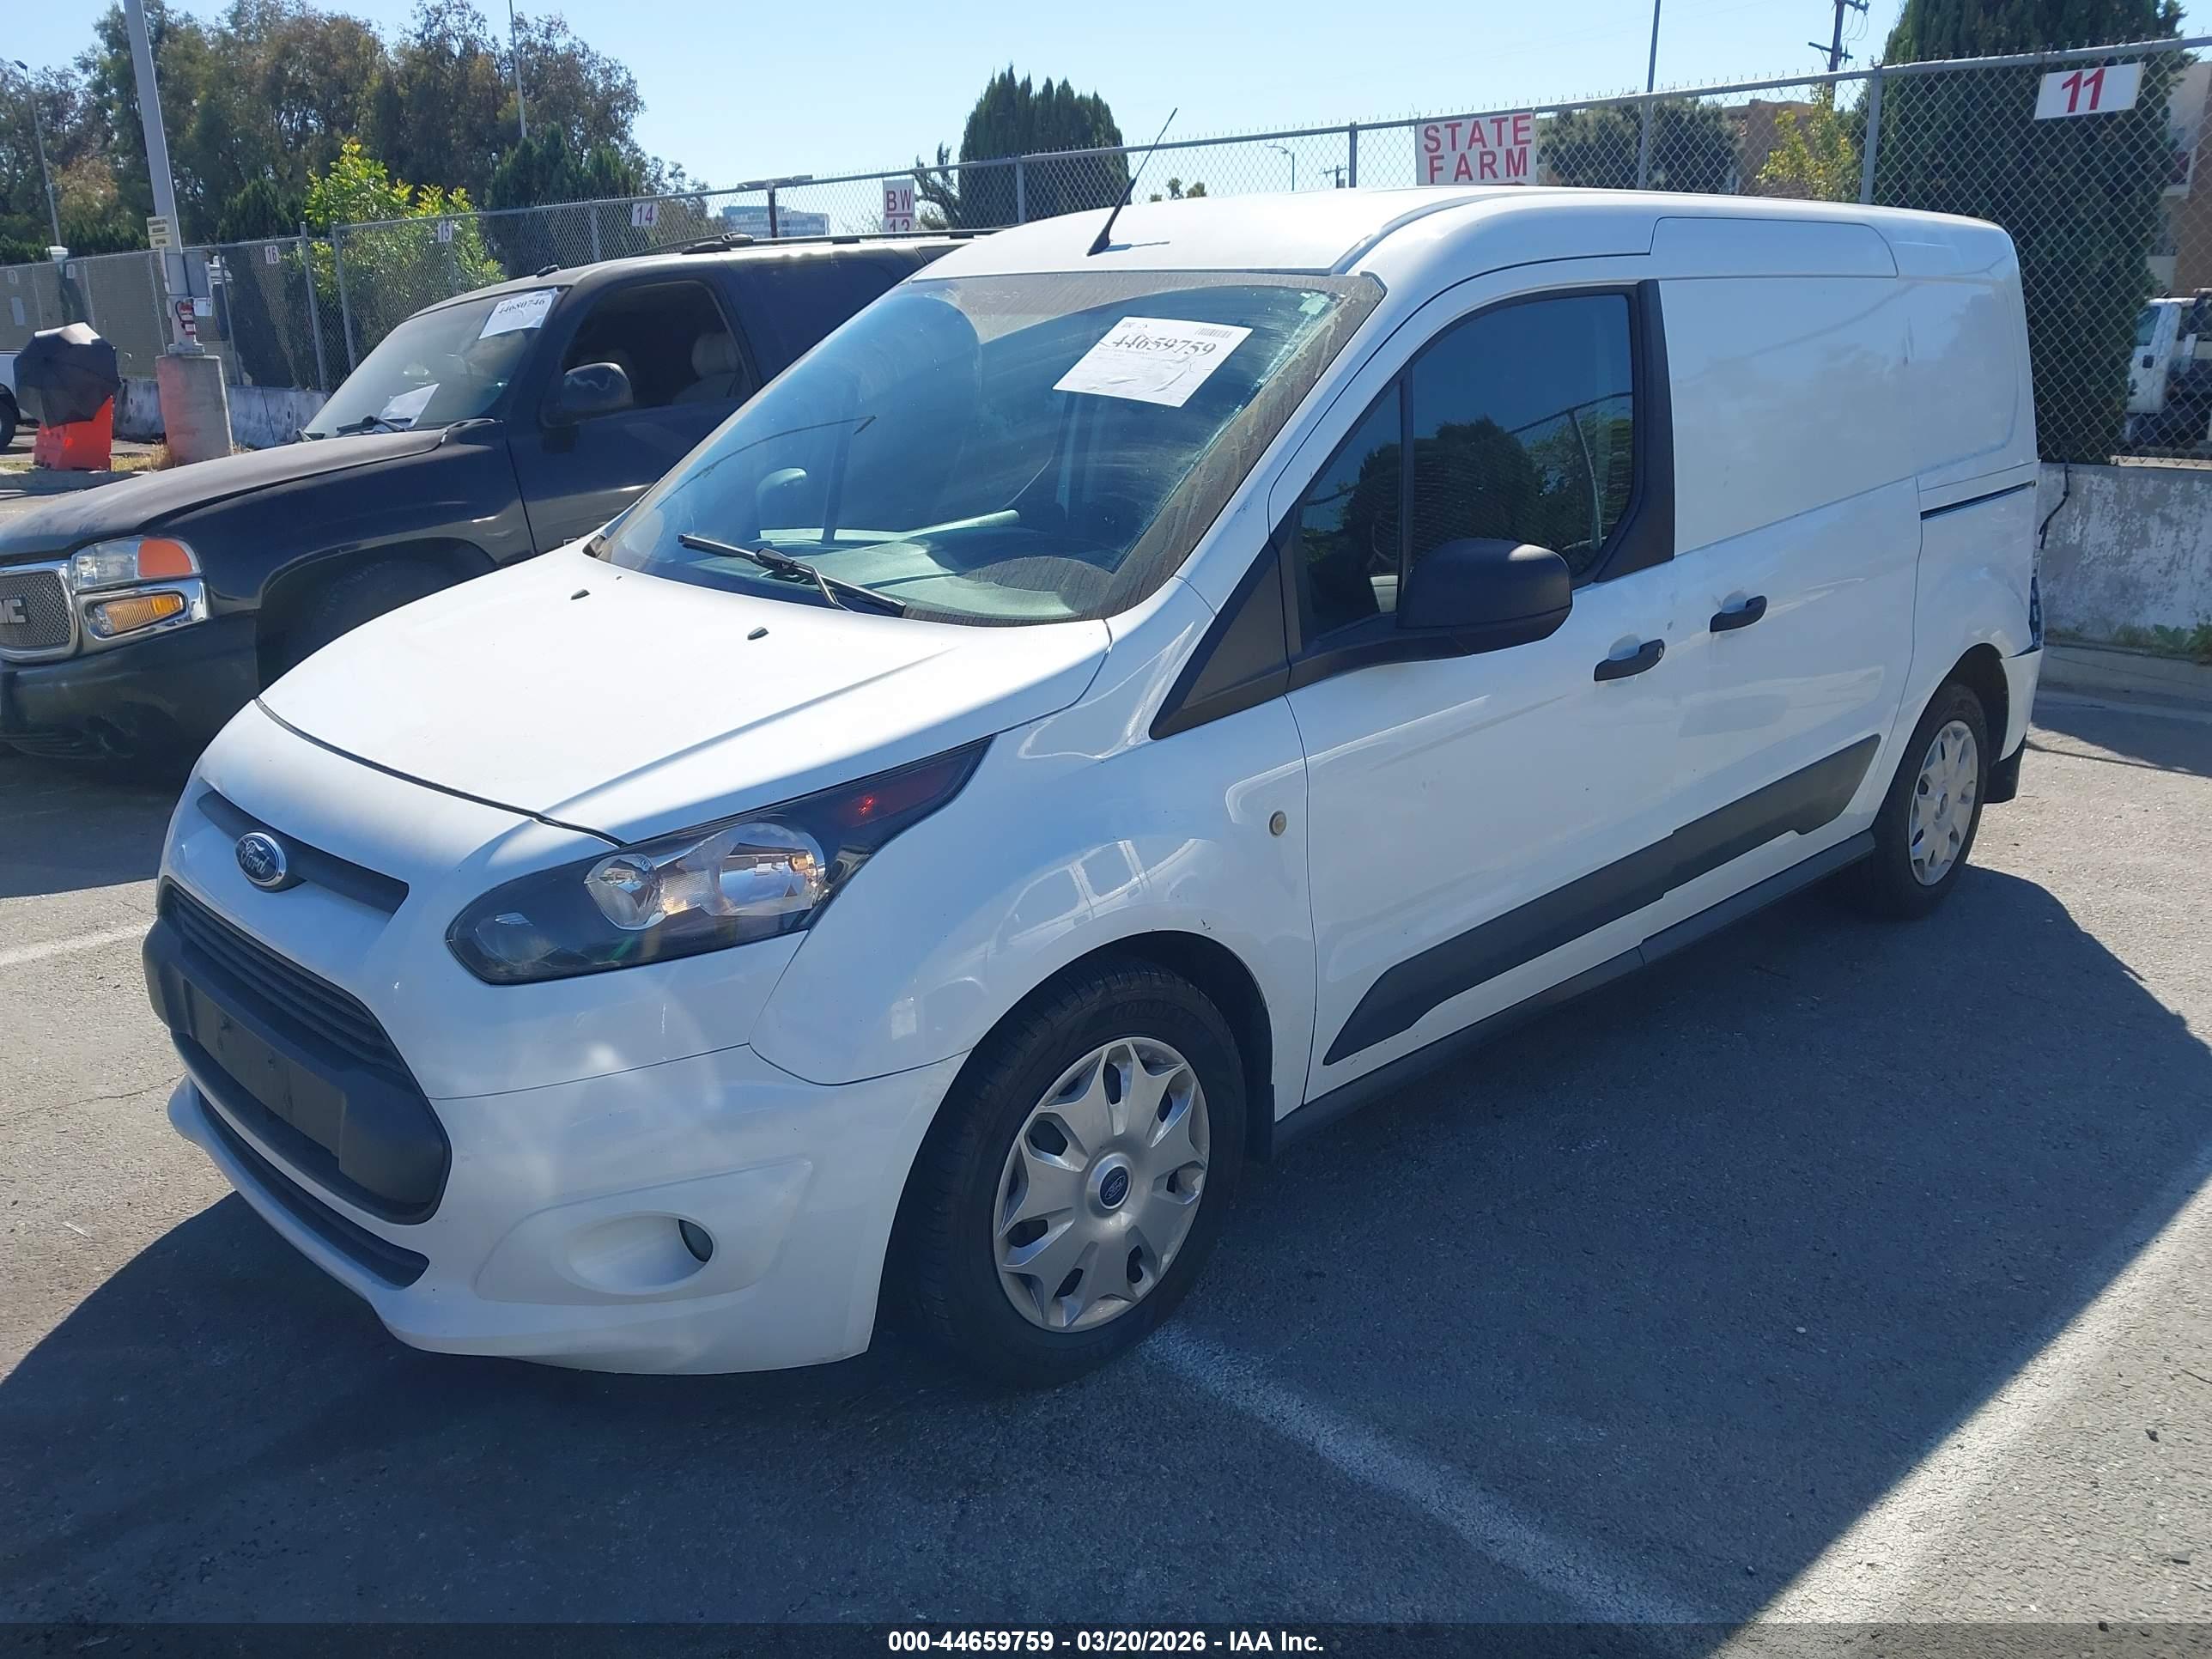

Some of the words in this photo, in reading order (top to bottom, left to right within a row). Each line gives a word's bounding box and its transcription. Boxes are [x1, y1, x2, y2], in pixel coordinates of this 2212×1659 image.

[2061, 68, 2106, 113] 11
[1423, 114, 1532, 153] STATE
[1428, 147, 1528, 184] FARM
[885, 189, 912, 212] BW
[636, 204, 653, 225] 14
[440, 222, 450, 240] 15
[267, 246, 277, 262] 16
[1111, 334, 1217, 357] 44659759
[241, 840, 270, 874] Ford
